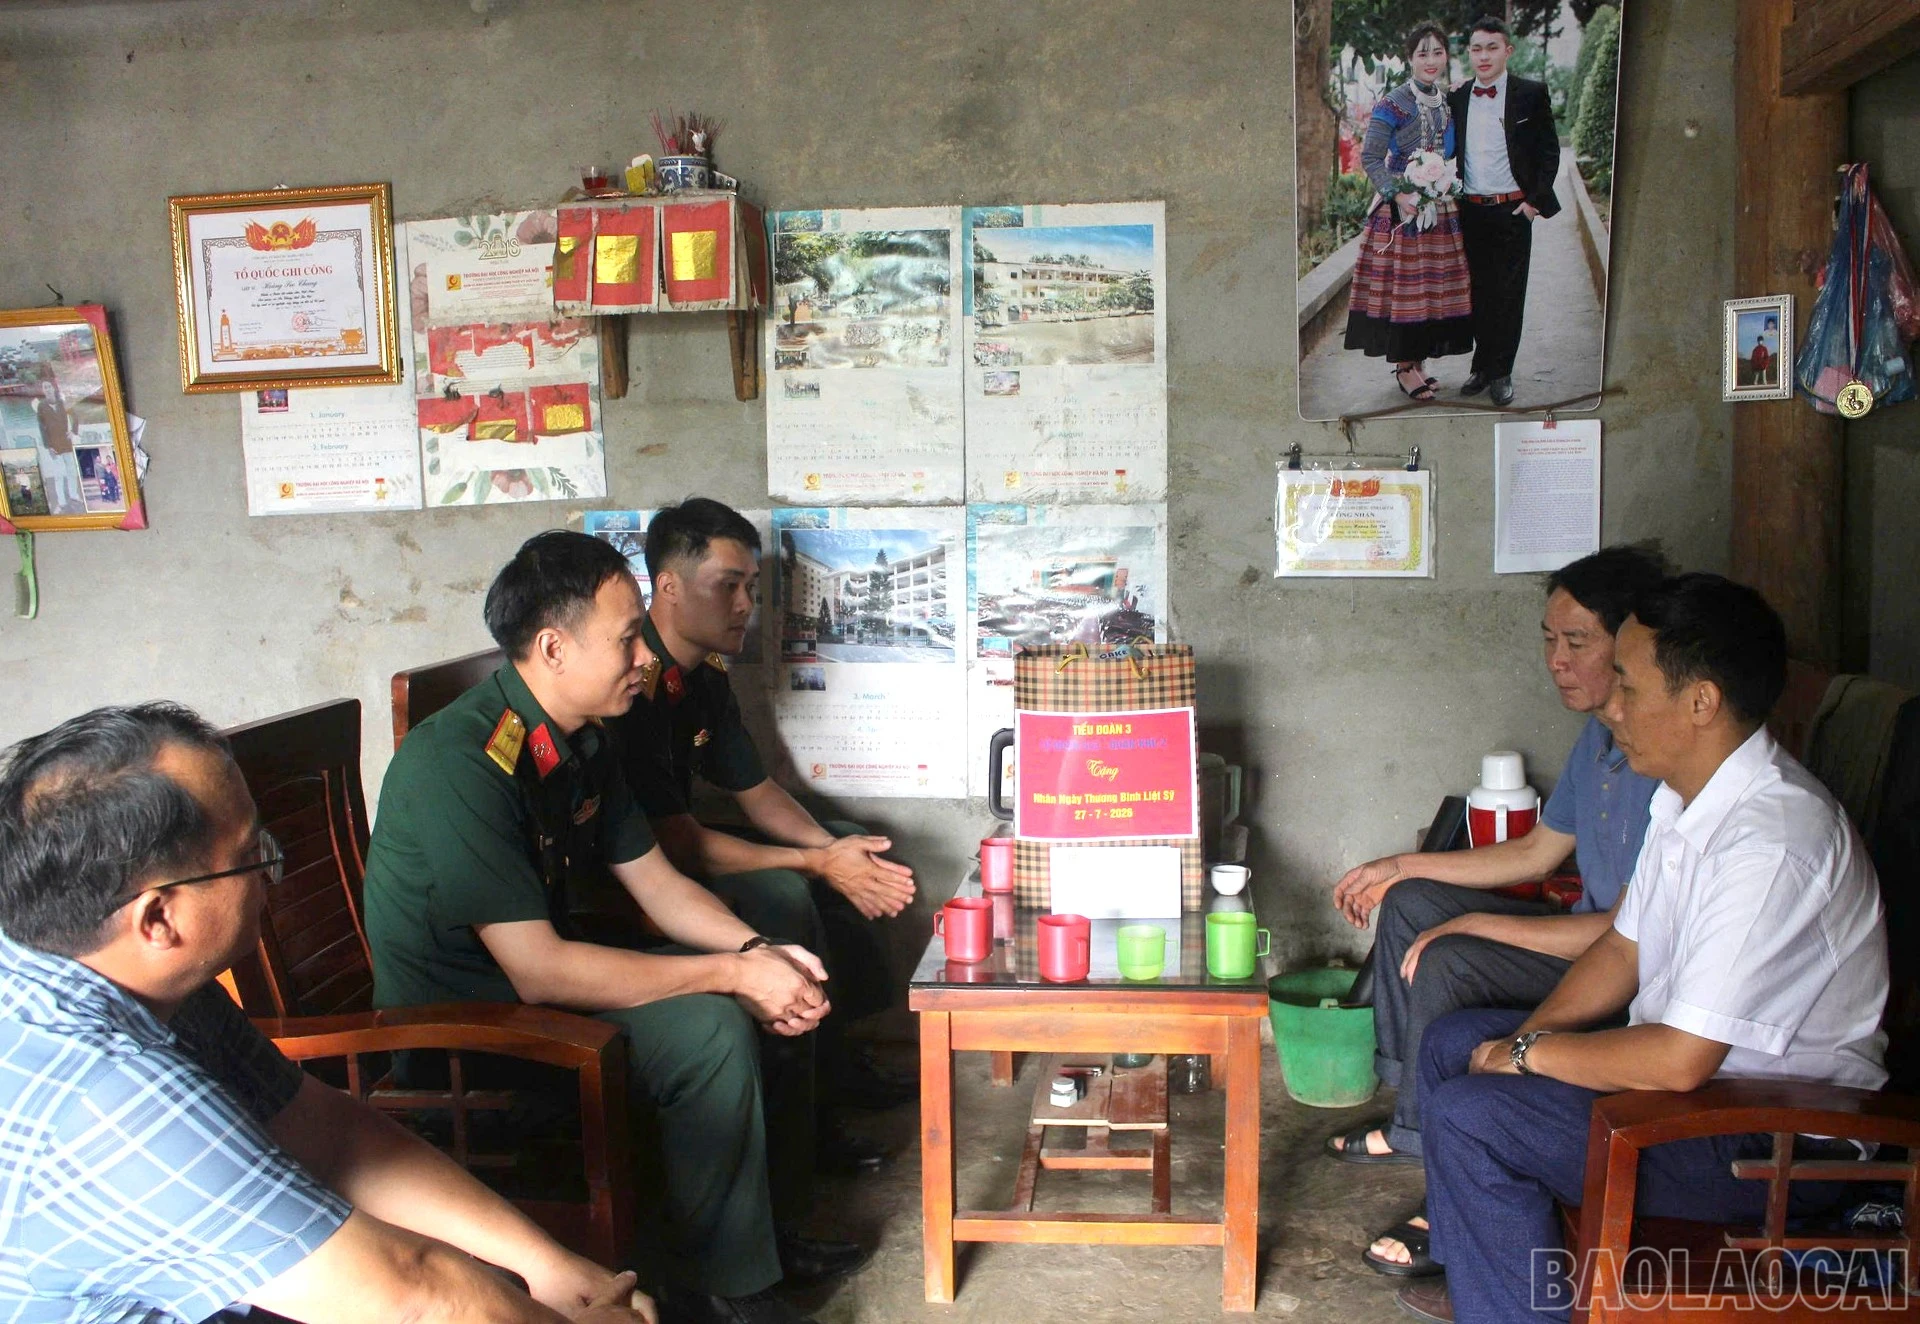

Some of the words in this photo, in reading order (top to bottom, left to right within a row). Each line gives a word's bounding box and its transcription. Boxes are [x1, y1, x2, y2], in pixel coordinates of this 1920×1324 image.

[234, 266, 249, 280] TỔ
[250, 265, 280, 280] QUỐC
[282, 268, 301, 278] GHI
[303, 264, 333, 276] CÔNG
[863, 692, 886, 700] March
[1096, 722, 1122, 736] ĐOÀN
[1125, 723, 1132, 735] 3
[1086, 759, 1119, 782] Tặng
[1033, 793, 1057, 804] Nhân
[1059, 793, 1082, 805] Ngày
[1085, 792, 1118, 804] Thương
[1144, 790, 1161, 803] Liệt
[1163, 789, 1175, 801] Sỹ
[1074, 810, 1087, 820] 27
[1095, 809, 1101, 820] 7
